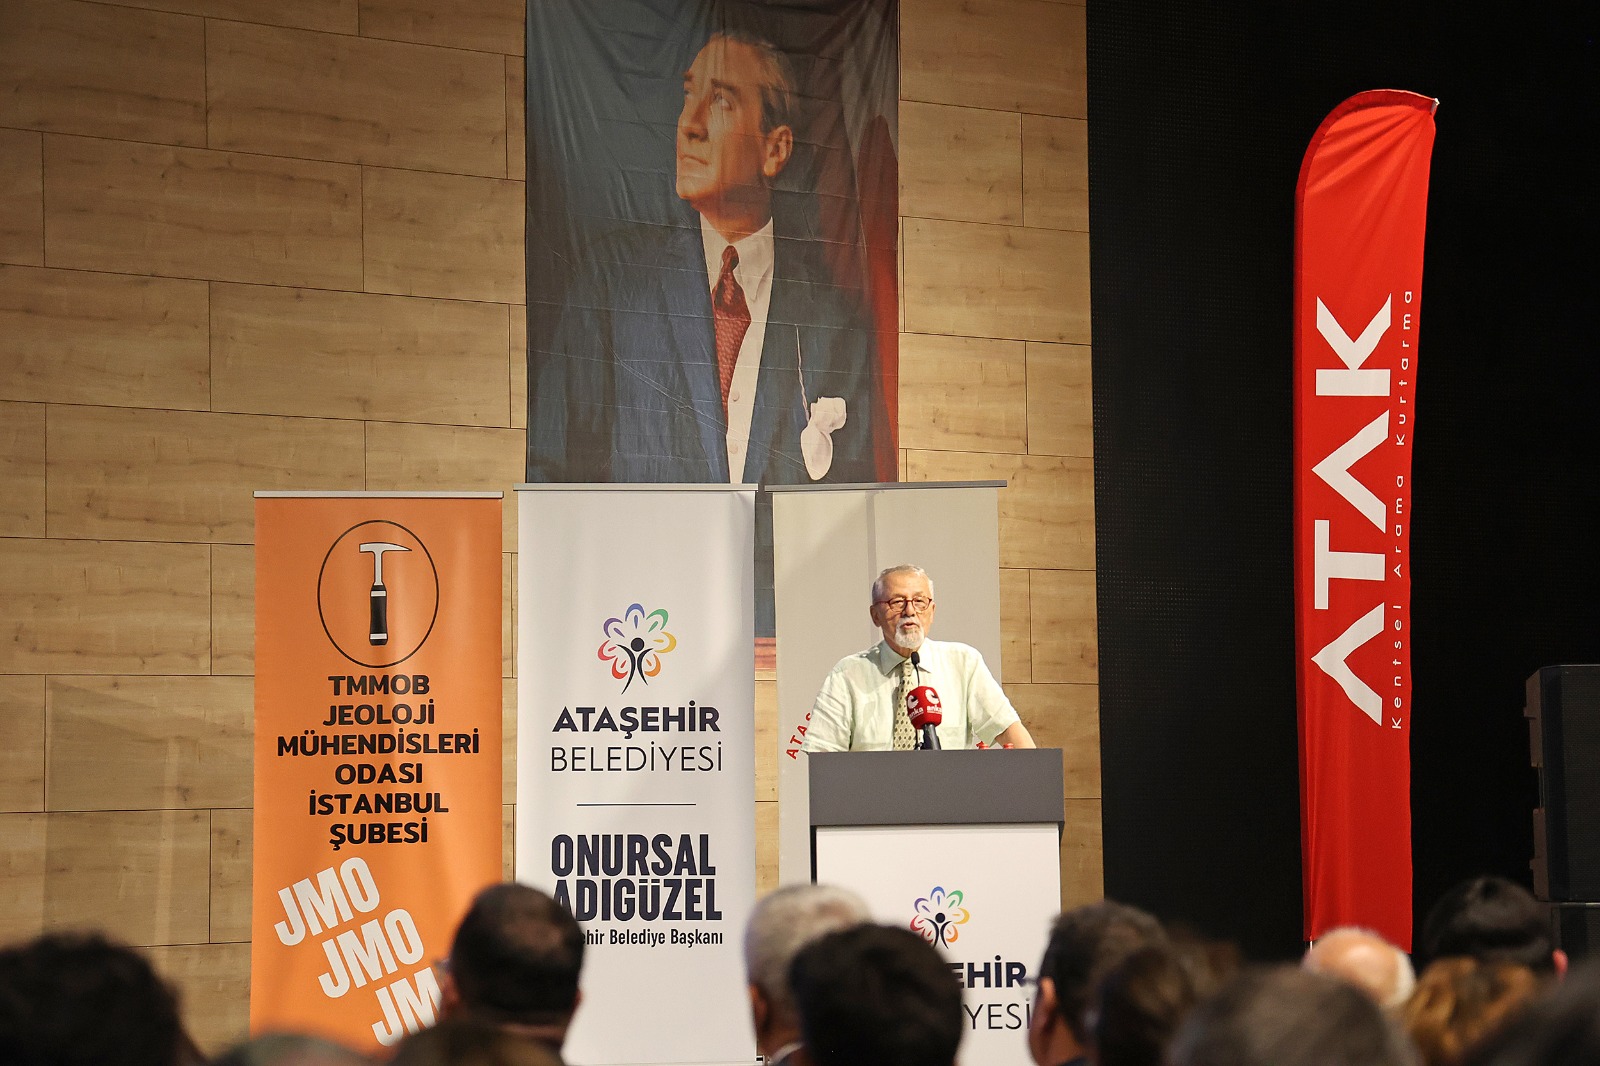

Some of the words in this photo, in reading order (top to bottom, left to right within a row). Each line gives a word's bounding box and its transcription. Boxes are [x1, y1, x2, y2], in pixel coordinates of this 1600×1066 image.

[1395, 291, 1413, 446] Kurtarma
[1311, 293, 1392, 726] ATAK
[1393, 475, 1404, 578] Arama
[327, 674, 430, 696] TMMOB
[1391, 605, 1402, 729] Kentsel
[322, 698, 435, 726] JEOLOJİ
[551, 700, 721, 740] ATAŞEHİR
[277, 728, 479, 757] MÜHENDİSLERİ
[551, 740, 722, 772] BELEDİYESİ
[786, 712, 811, 760] ATA
[334, 763, 423, 785] ODASI
[309, 789, 449, 816] İSTANBUL
[329, 817, 428, 851] ŞUBESİ
[551, 833, 716, 877] ONURSAL
[273, 856, 380, 946] JMO
[552, 878, 723, 922] ADIGÜZEL
[317, 908, 424, 998] JMO
[610, 928, 665, 948] Belediye
[670, 928, 723, 949] Başkanı
[946, 954, 1027, 988] EHİR
[371, 966, 443, 1047] JM
[963, 997, 1031, 1030] YESİ
